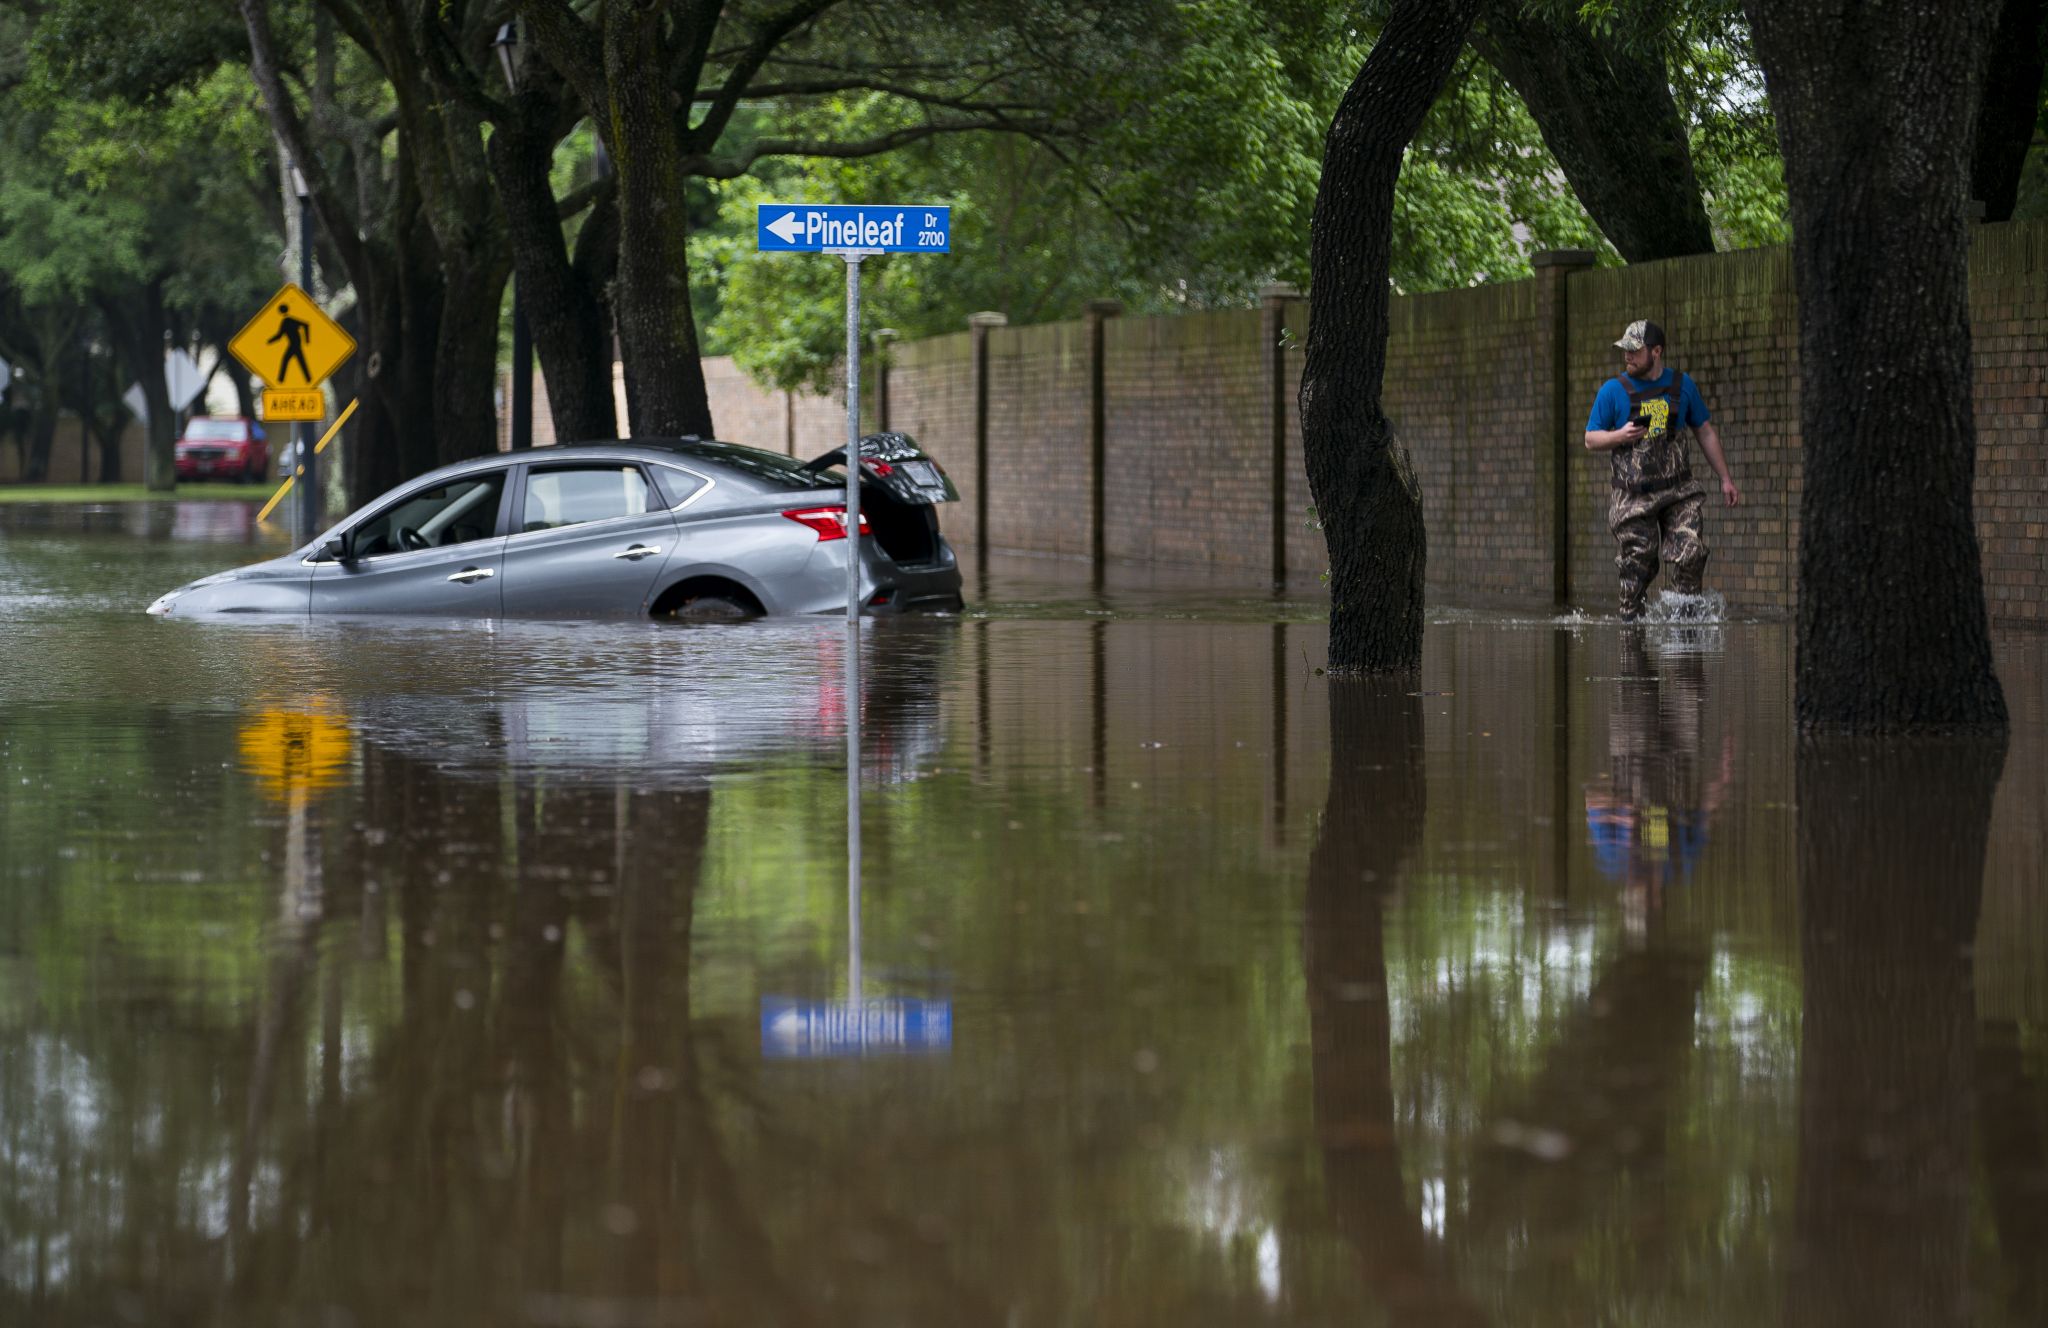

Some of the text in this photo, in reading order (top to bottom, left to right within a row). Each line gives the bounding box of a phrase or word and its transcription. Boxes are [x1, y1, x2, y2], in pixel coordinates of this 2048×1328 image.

[925, 213, 938, 228] Dr
[807, 212, 904, 246] Pineleaf
[918, 231, 945, 246] 2700
[271, 399, 316, 411] AHEAD
